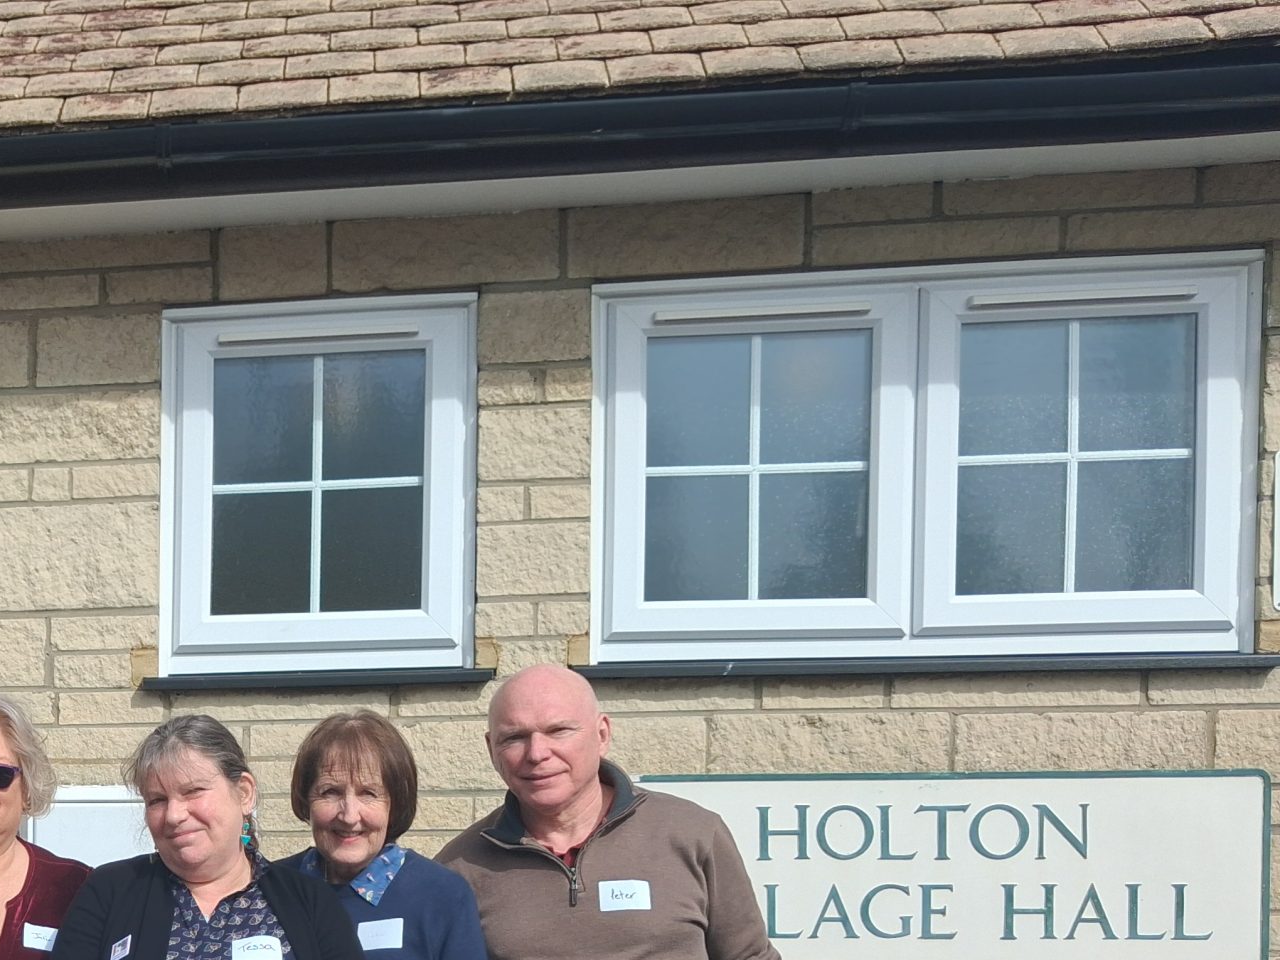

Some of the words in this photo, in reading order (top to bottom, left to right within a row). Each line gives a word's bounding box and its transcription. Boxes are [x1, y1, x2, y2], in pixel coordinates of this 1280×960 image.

[755, 803, 1091, 862] HOLTON
[762, 883, 958, 941] LAGE
[999, 882, 1215, 942] HALL
